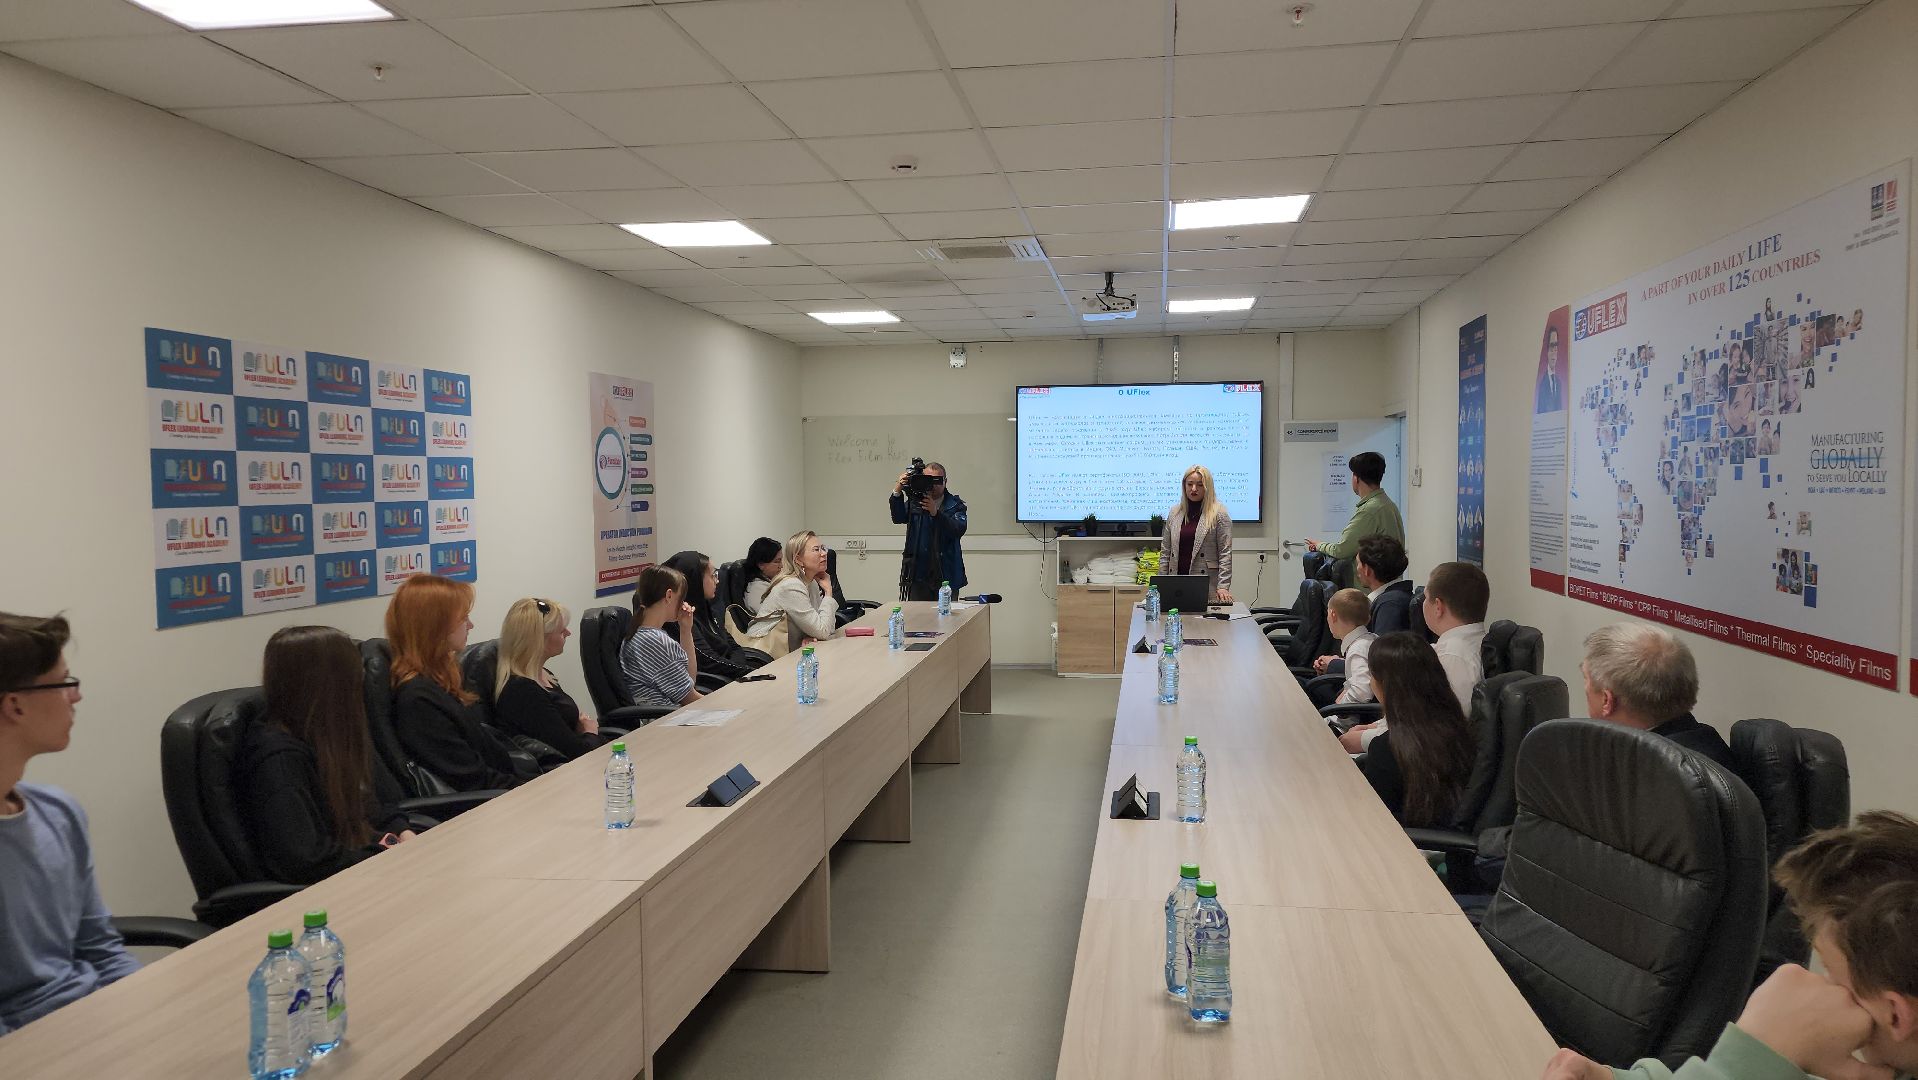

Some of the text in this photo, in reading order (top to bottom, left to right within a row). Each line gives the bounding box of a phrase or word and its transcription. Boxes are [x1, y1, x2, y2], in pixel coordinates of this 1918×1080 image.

[1648, 280, 1670, 299] PART
[1671, 275, 1683, 291] OF
[1683, 264, 1711, 287] YOUR
[1713, 250, 1747, 275] DAILY
[1748, 233, 1782, 262] LIFE
[1688, 249, 1821, 305] IN OVER 125 COUNTRIES
[1587, 294, 1627, 334] UFLEX
[1810, 447, 1885, 469] GLOBALLY
[1811, 431, 1884, 447] MANUFACTURING
[1848, 469, 1887, 482] LOCALLY
[1569, 583, 1892, 681] BOPET Films BOPP Films CPP Films Metallised Films Thermal Films Speciality Films
